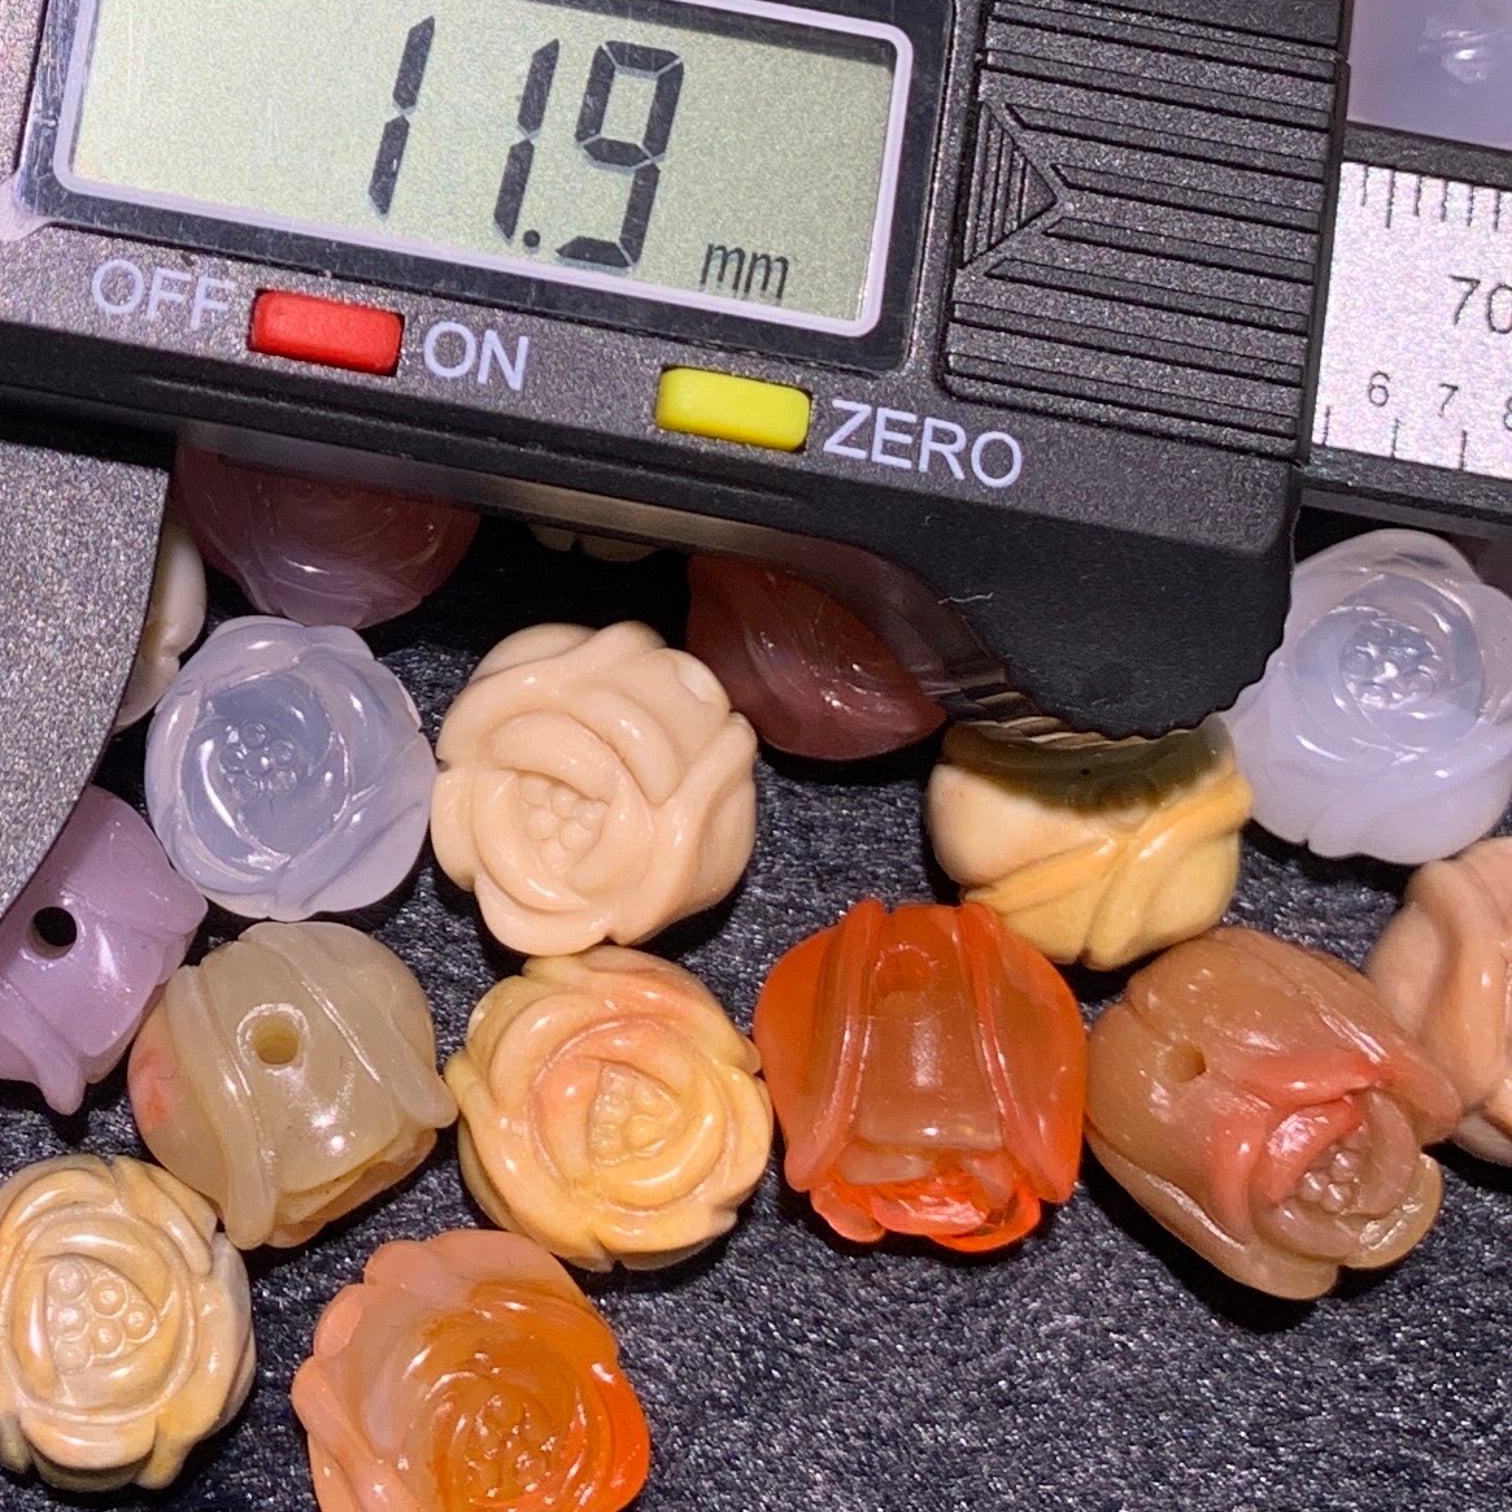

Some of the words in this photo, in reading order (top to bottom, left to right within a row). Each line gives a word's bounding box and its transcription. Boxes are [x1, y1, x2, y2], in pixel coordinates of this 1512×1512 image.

[368, 14, 685, 272] 11.9
[699, 240, 790, 304] mm
[88, 259, 238, 338] OFF
[423, 319, 530, 390] ON
[1449, 274, 1512, 334] 70
[1368, 371, 1390, 408] 6
[1438, 383, 1460, 418] 7
[823, 396, 1023, 488] ZERO
